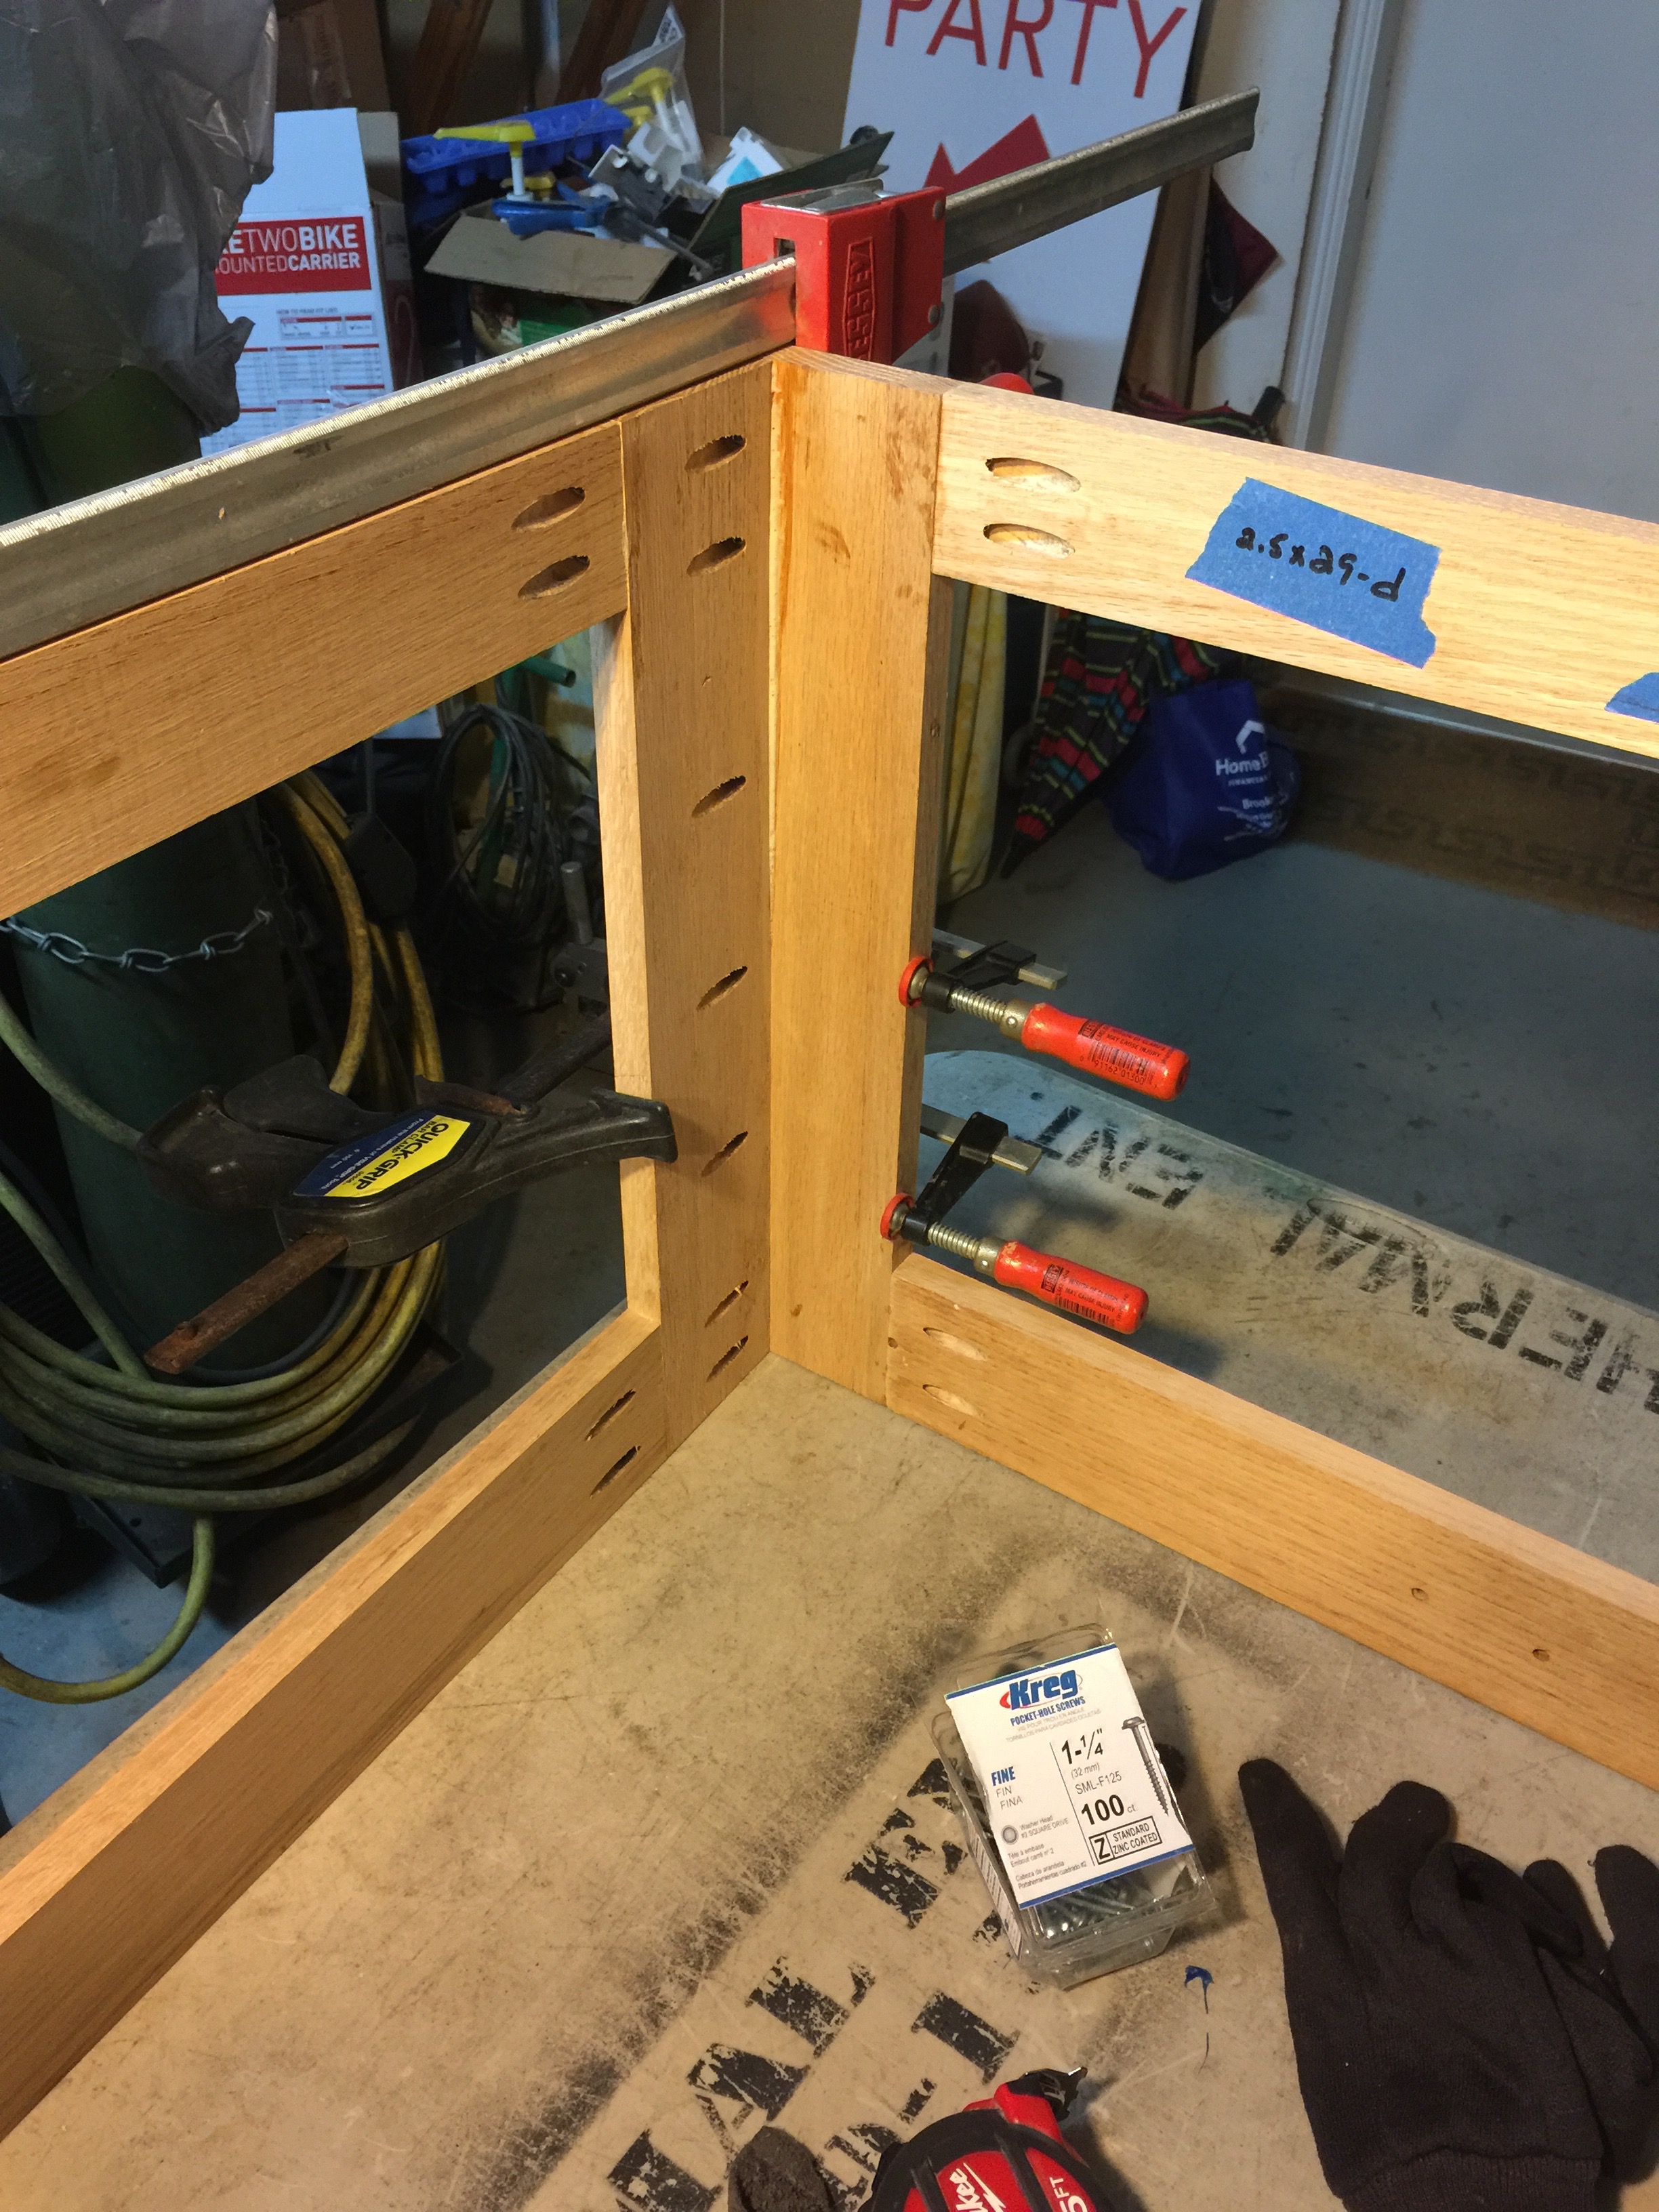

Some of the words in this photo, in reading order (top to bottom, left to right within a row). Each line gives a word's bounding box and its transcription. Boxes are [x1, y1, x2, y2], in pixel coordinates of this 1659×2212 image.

[886, 0, 1186, 98] PARTY
[1120, 1038, 1139, 1050] CAUSE
[1140, 1045, 1161, 1057] INJURY
[416, 1120, 436, 1132] BAR
[388, 1133, 419, 1153] CLAMP
[1008, 1670, 1078, 1711] Kreg
[1010, 1704, 1056, 1727] POCKET-HOLE
[1055, 1696, 1086, 1712] SCREWS
[991, 1767, 1016, 1786] FINE
[1071, 1768, 1083, 1779] (32
[1083, 1763, 1100, 1775] mm)
[996, 1785, 1012, 1797] FIN
[1075, 1771, 1122, 1794] SML-F125
[1000, 1796, 1023, 1809] FINA
[1082, 1795, 1124, 1825] 100
[1039, 1814, 1054, 1824] Head
[1027, 1823, 1052, 1837] SQUARE
[1113, 1823, 1149, 1841] STANDARD
[1113, 1842, 1129, 1854] ZINC
[1130, 1832, 1158, 1848] COATED
